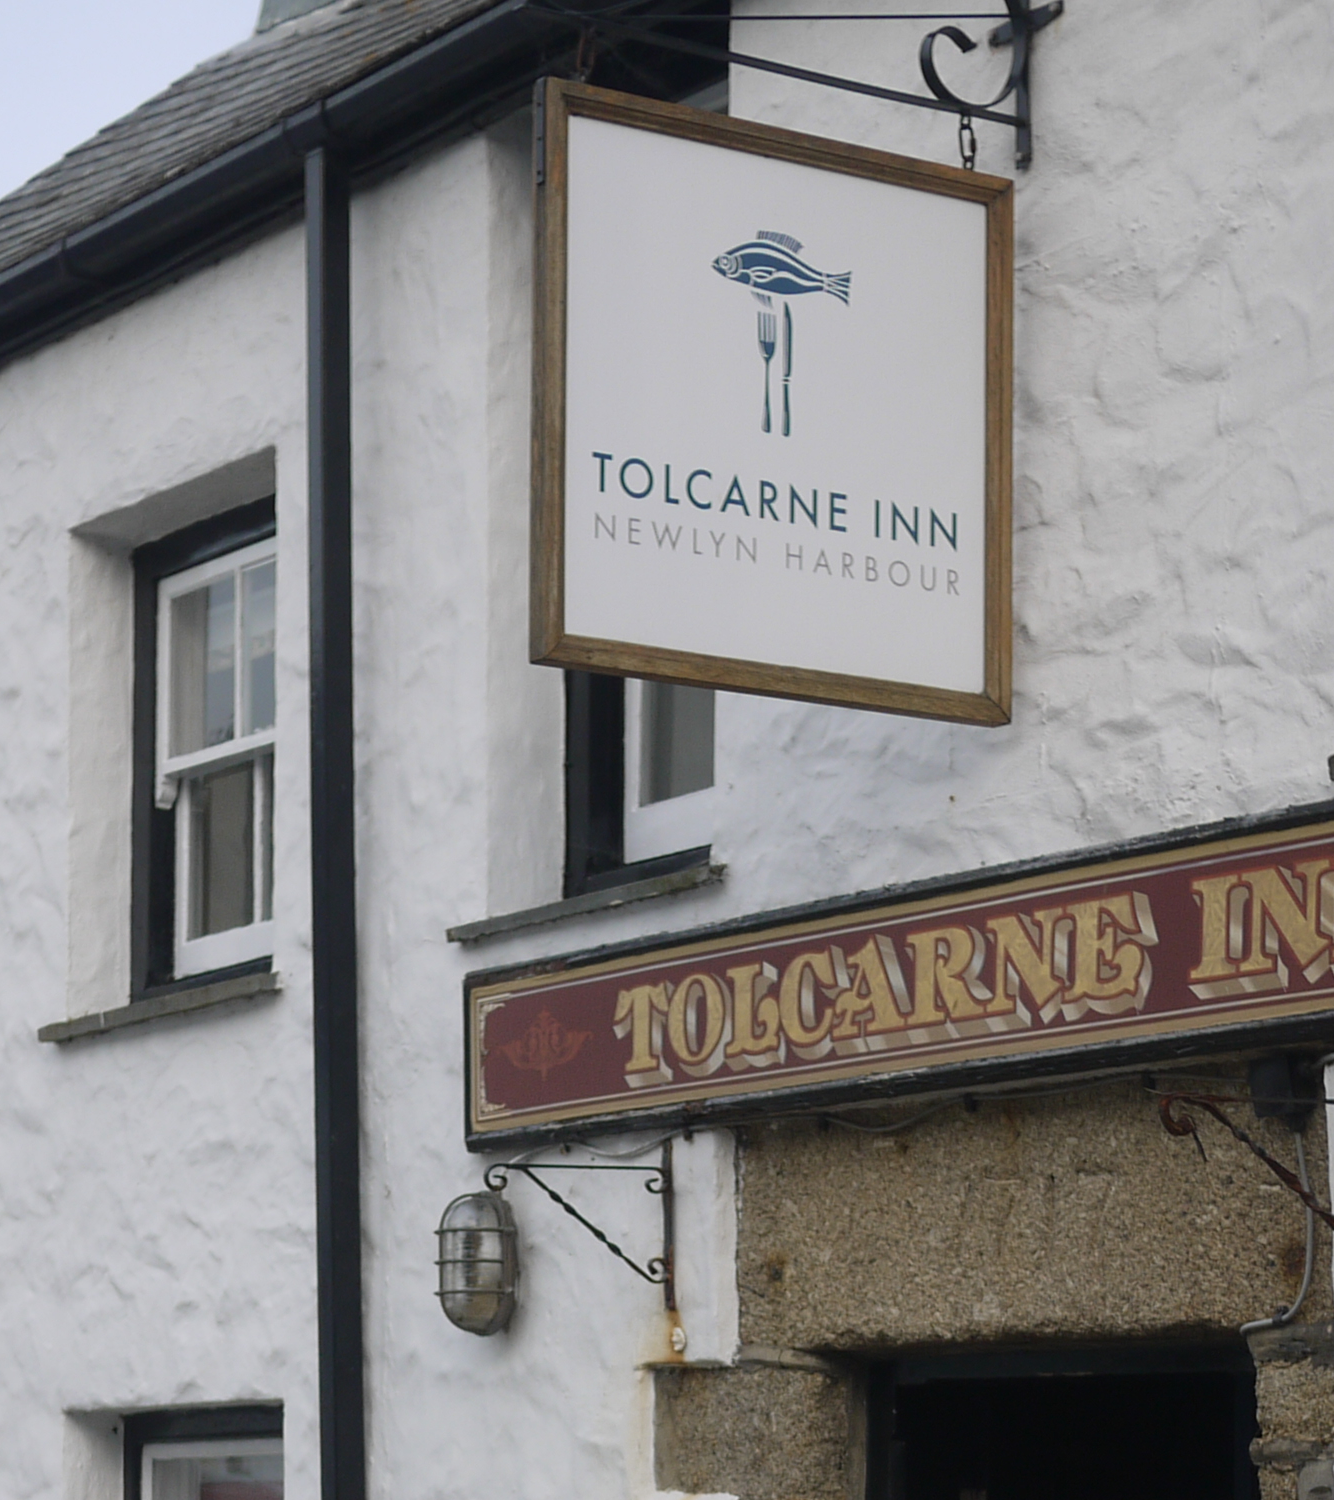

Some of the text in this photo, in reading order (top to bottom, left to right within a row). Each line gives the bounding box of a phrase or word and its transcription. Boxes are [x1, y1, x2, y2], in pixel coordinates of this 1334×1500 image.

[592, 451, 958, 552] TOLCARNE INN
[594, 512, 960, 596] NEWLYN HARBOUR
[613, 893, 1157, 1088] TOLCARNE
